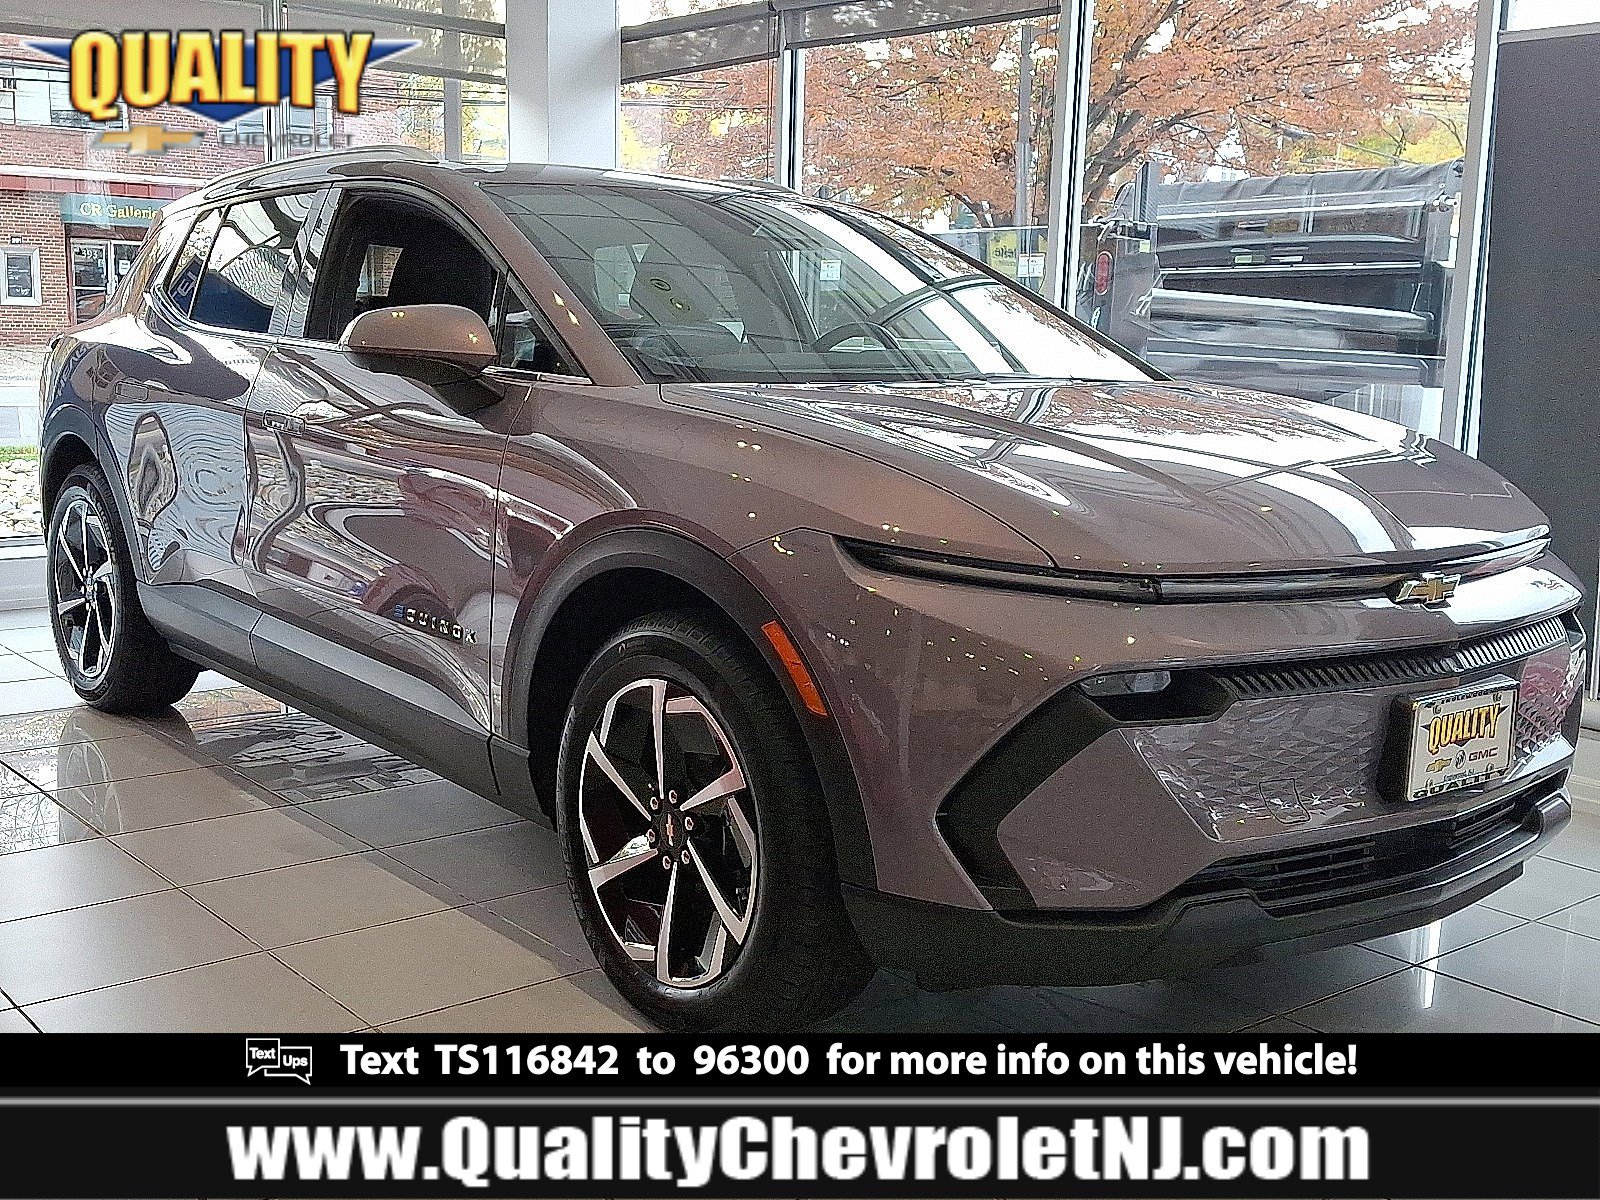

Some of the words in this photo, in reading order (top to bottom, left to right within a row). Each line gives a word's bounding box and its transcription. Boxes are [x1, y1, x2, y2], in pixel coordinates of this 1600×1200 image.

[80, 202, 102, 216] CR
[1428, 703, 1500, 755] QUALITY
[1469, 747, 1498, 761] GMC
[1413, 769, 1510, 799] QUALITY
